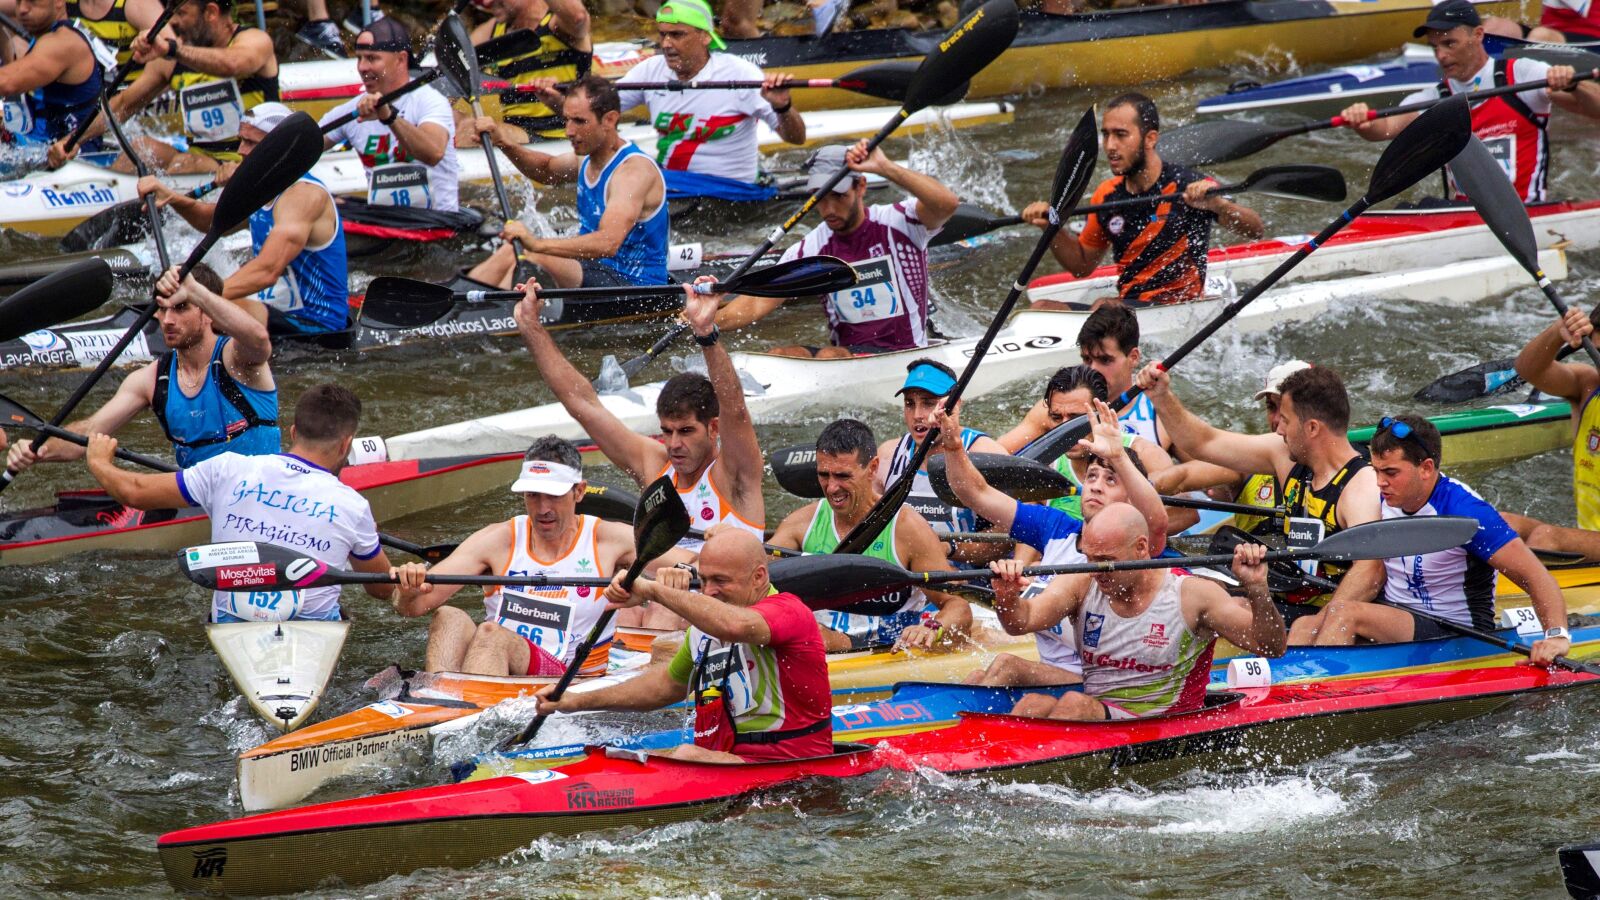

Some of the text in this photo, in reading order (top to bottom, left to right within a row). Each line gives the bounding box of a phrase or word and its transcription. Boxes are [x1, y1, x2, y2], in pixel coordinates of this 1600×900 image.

[186, 89, 229, 105] Liberbank
[201, 107, 224, 128] 99
[376, 171, 421, 184] Liberbank
[390, 189, 411, 208] 18
[680, 247, 694, 261] 42
[850, 287, 877, 309] 34
[0, 349, 75, 368] Lavandera
[362, 440, 377, 453] 60
[228, 480, 339, 523] GALICIA
[222, 513, 332, 552] PIRAGÜISMO
[243, 578, 265, 586] Rialto
[248, 590, 283, 611] 152
[506, 601, 561, 623] Liberbank
[1516, 608, 1535, 622] 93
[516, 624, 543, 646] 66
[1245, 661, 1262, 676] 96
[290, 748, 320, 772] BMW
[322, 743, 354, 763] Official
[356, 740, 390, 757] Partner
